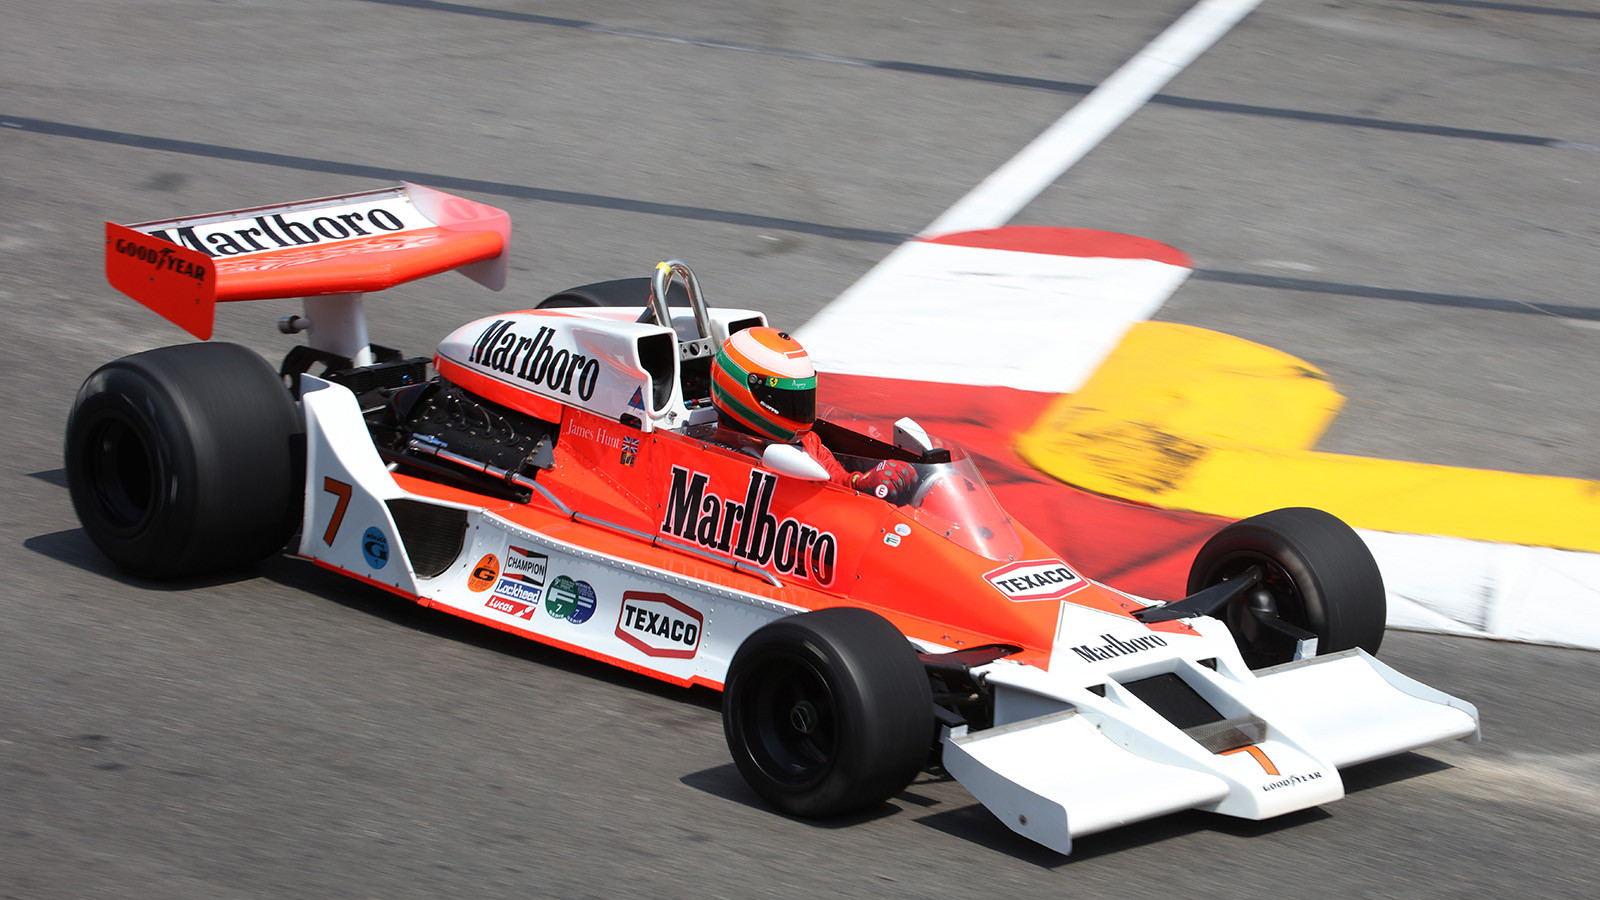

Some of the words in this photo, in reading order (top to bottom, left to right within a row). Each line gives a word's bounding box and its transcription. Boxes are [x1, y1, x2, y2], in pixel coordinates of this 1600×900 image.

[148, 206, 405, 258] Marlboro
[468, 319, 600, 401] Marlboro
[566, 418, 594, 440] James
[596, 429, 620, 449] Hunt
[323, 476, 352, 547] 7
[660, 464, 837, 588] Marlboro
[473, 567, 496, 581] G
[508, 556, 545, 576] CHAMPION
[996, 567, 1076, 593] TEXACO
[488, 597, 514, 612] Lucas
[496, 579, 541, 603] Lockheed
[555, 604, 562, 613] 7
[625, 604, 698, 646] TEXACO
[1071, 633, 1168, 663] Marlboro
[1262, 771, 1322, 791] GOODYEAR
